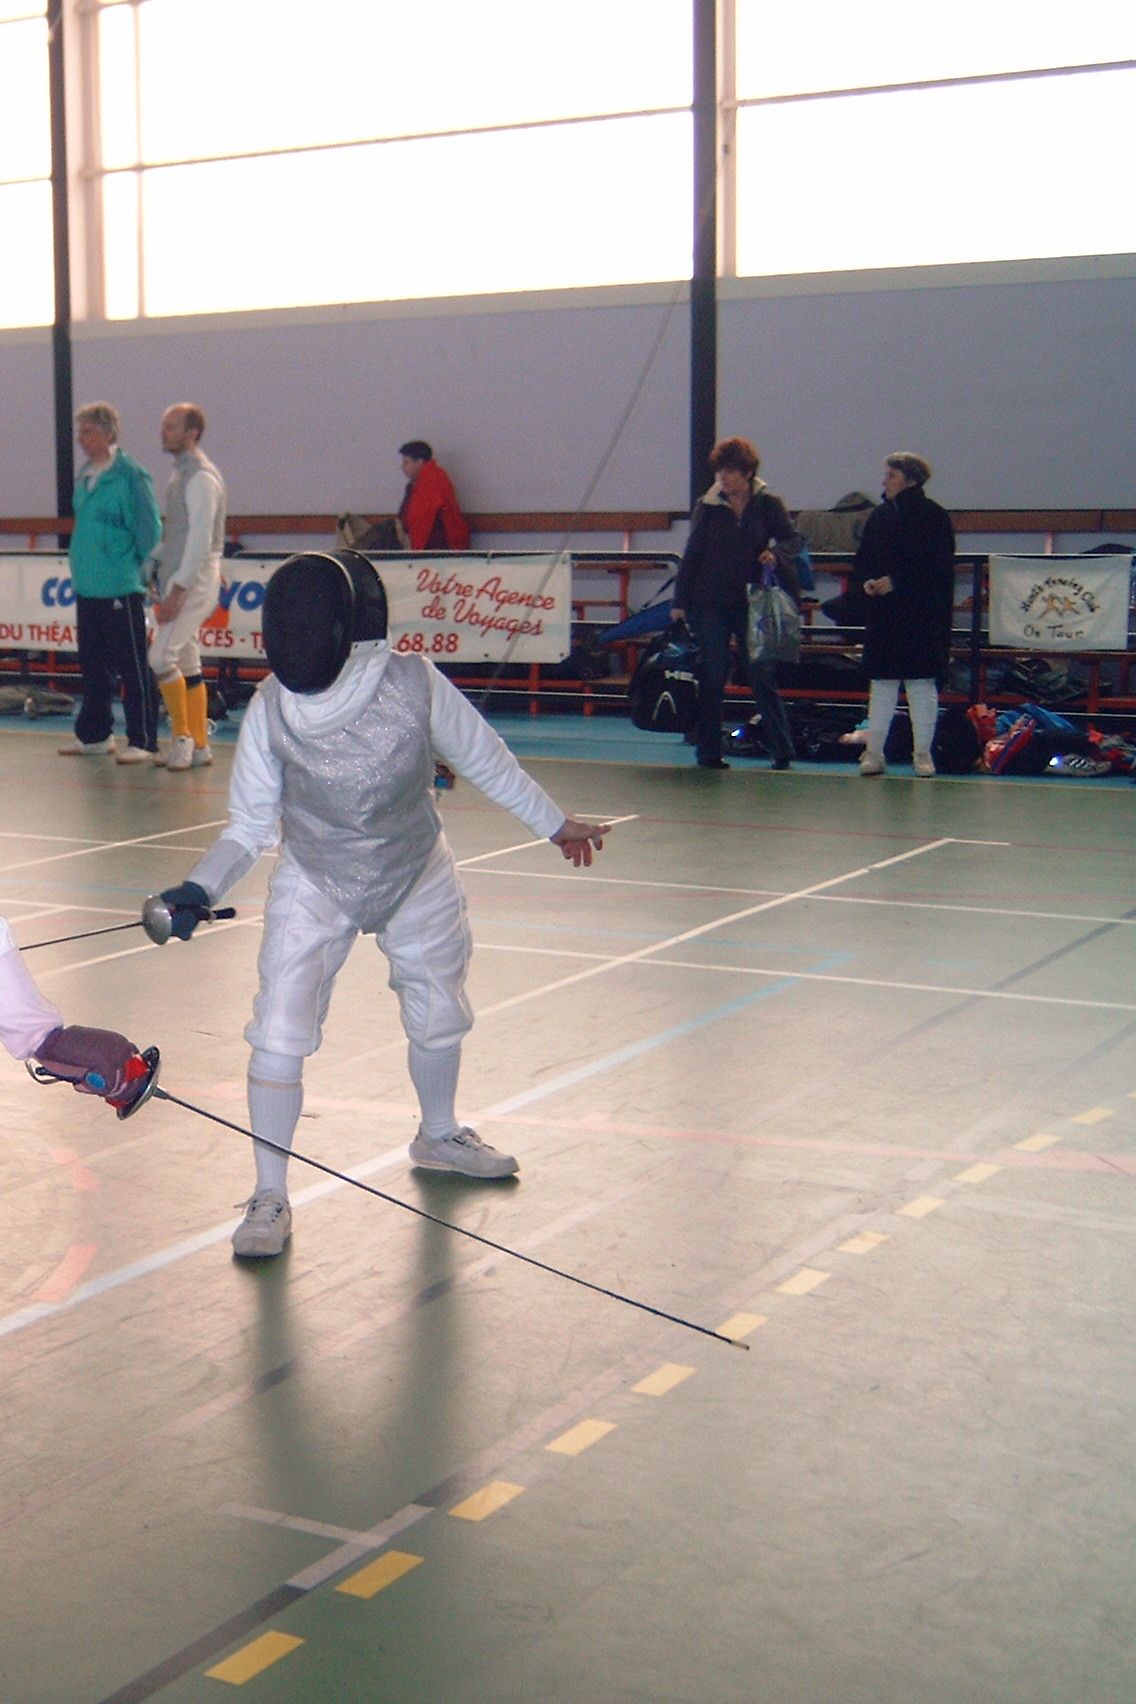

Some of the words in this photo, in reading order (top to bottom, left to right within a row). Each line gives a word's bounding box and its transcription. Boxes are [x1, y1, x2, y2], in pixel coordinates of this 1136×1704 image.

[416, 569, 474, 597] Votre
[475, 576, 556, 612] Agence
[27, 620, 78, 643] THÉA
[421, 594, 447, 620] de
[452, 598, 544, 642] Voyages
[198, 629, 235, 648] CES
